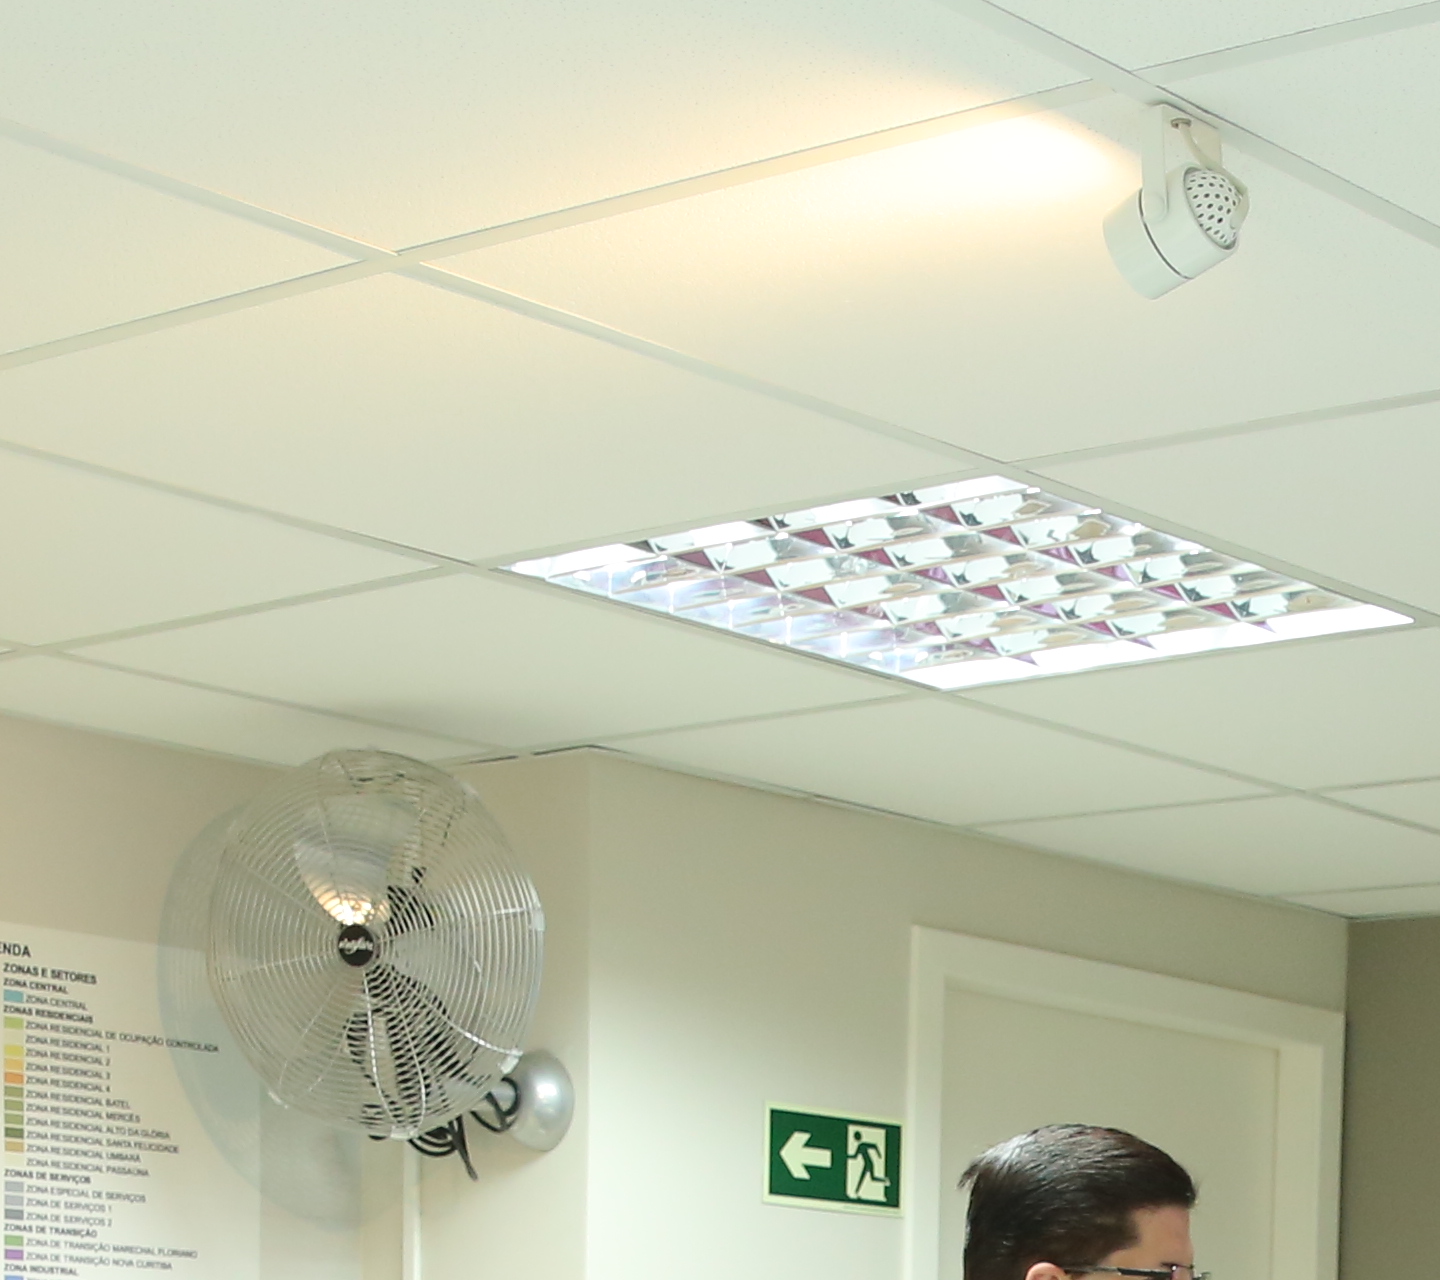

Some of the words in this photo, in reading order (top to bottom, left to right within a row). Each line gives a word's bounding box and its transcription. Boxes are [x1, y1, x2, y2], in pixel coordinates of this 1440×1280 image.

[3, 963, 39, 977] ZONAS
[41, 968, 47, 978] E
[51, 969, 97, 984] SETORES
[3, 978, 27, 988] ZONA
[30, 981, 68, 994] CENTRAL
[25, 995, 48, 1005] ZONA
[50, 997, 88, 1011] CENTRAL
[3, 1005, 32, 1016] ZONAS
[35, 1008, 93, 1023] RESIDENCIAIS
[25, 1021, 48, 1031] ZONA
[50, 1024, 103, 1039] RESIDENCIAL
[166, 1038, 218, 1052] CONTROLADA
[4, 1169, 33, 1179] ZONAS
[36, 1171, 47, 1180] DE
[50, 1172, 91, 1185] SERVIÇOS
[4, 1223, 32, 1233] ZONAS
[36, 1225, 47, 1235] DE
[50, 1225, 97, 1238] TRANSIÇÃO
[4, 1264, 27, 1274] ZONA
[30, 1265, 79, 1276] INDUSTRIAL
